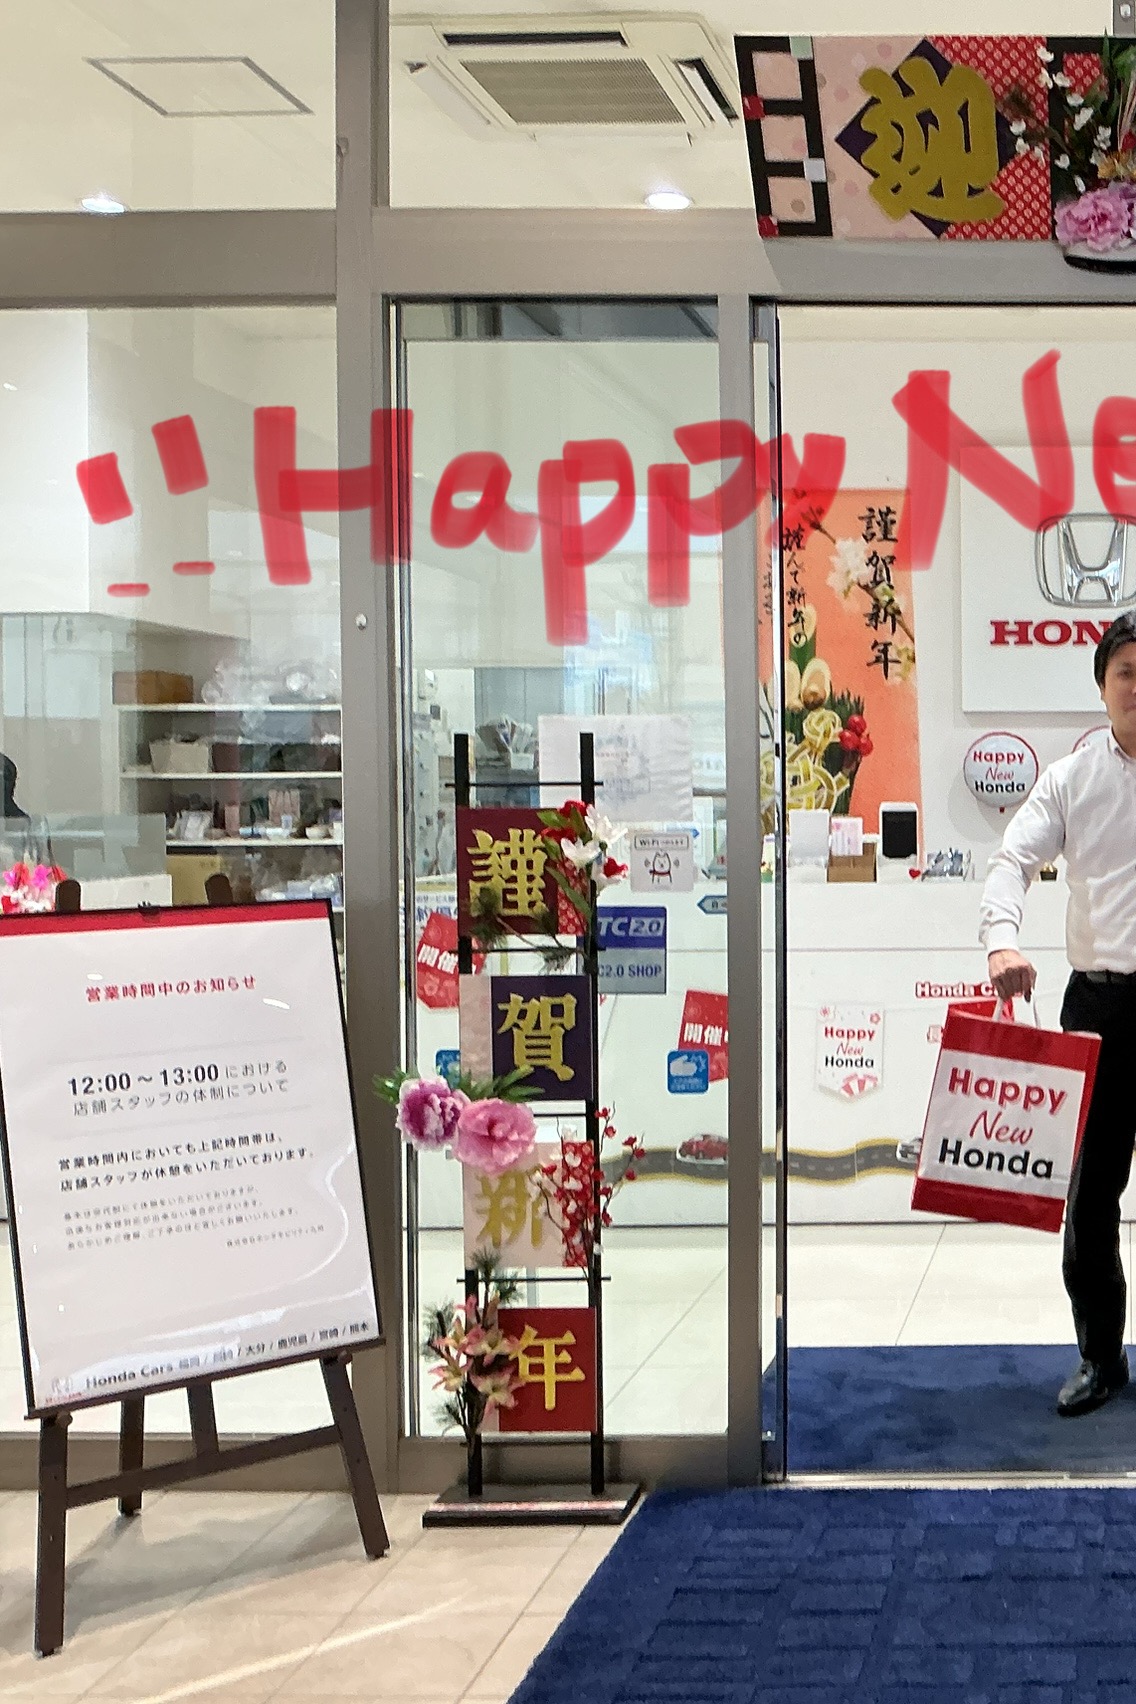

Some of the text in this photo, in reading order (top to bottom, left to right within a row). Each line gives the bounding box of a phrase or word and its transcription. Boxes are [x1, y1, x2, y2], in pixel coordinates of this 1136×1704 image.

[858, 505, 902, 681] 謹賀新年
[973, 750, 1025, 765] Happy
[974, 781, 1026, 794] Honda
[985, 766, 1015, 782] New
[628, 964, 662, 978] SHOP
[86, 975, 256, 1003] 営業時間中のお知らせ
[915, 981, 975, 998] Honda
[824, 1026, 876, 1042] Happy
[824, 1055, 875, 1069] Honda
[836, 1042, 865, 1056] New
[74, 1079, 289, 1117] 店舗スタッフの体制について
[948, 1067, 1066, 1114] Happy
[969, 1110, 1034, 1145] New
[59, 1132, 282, 1171] 営業時間内においても上記時間帯は、
[938, 1138, 1054, 1180] Honda
[60, 1148, 315, 1193] 店舗スタッフが休憩をいただいております。
[86, 1369, 136, 1390] Honda
[141, 1363, 173, 1379] Cars
